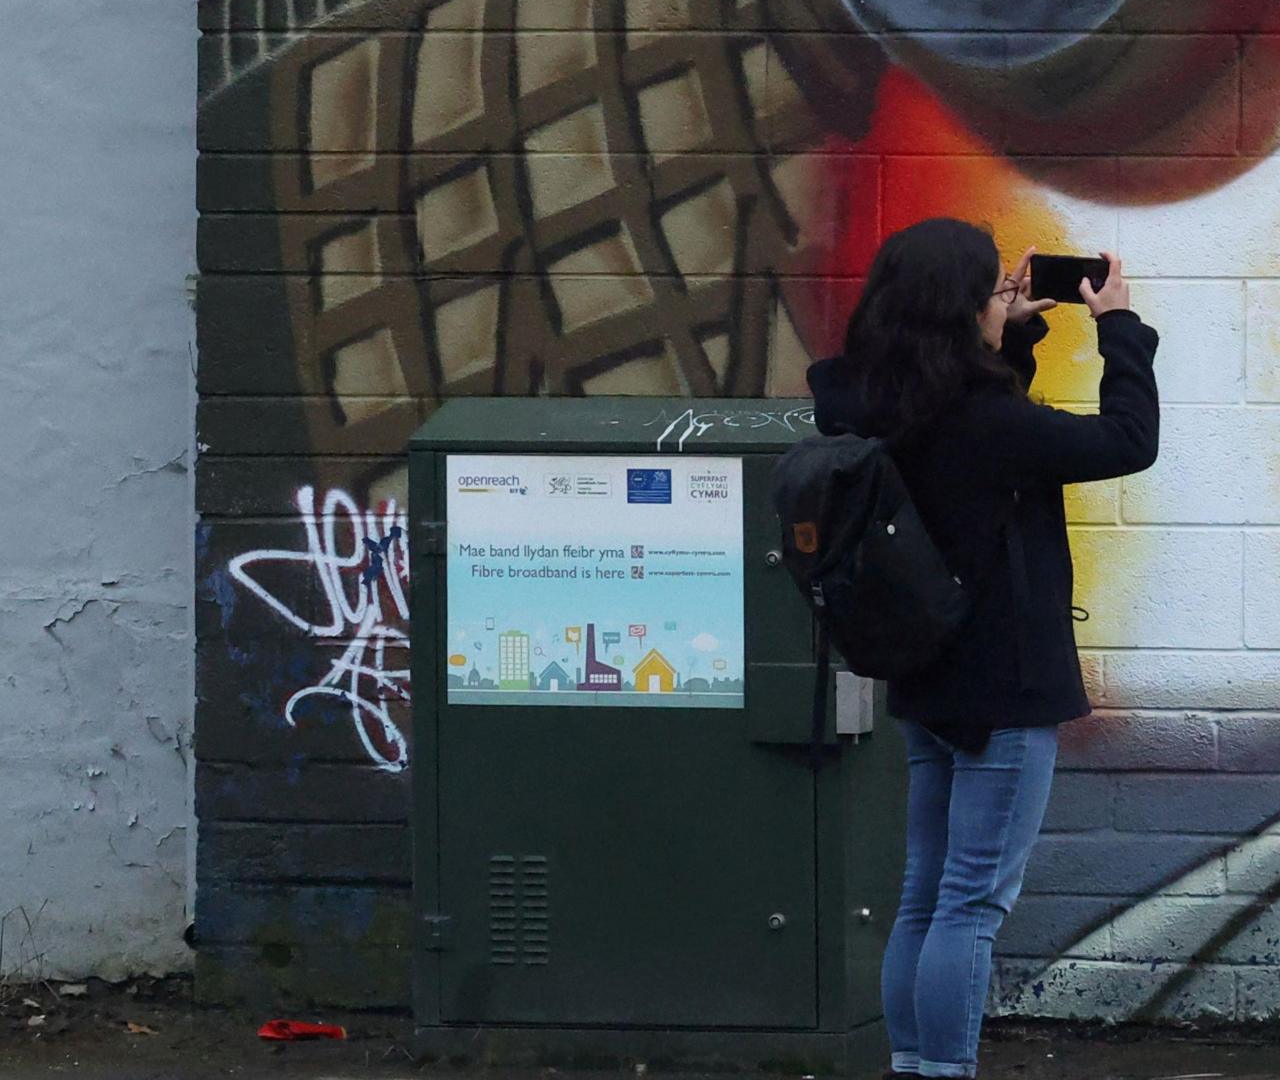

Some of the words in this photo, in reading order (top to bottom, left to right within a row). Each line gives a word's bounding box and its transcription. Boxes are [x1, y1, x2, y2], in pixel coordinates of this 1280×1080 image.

[458, 475, 520, 487] openreach
[690, 489, 728, 499] CYMRU
[459, 544, 486, 557] Mae
[490, 545, 520, 558] band
[523, 545, 559, 561] llydan
[563, 545, 595, 559] ffeibr
[599, 549, 625, 562] yma
[471, 565, 504, 578] Fibre
[508, 565, 577, 579] broadband
[582, 566, 591, 579] is
[595, 566, 625, 579] here
